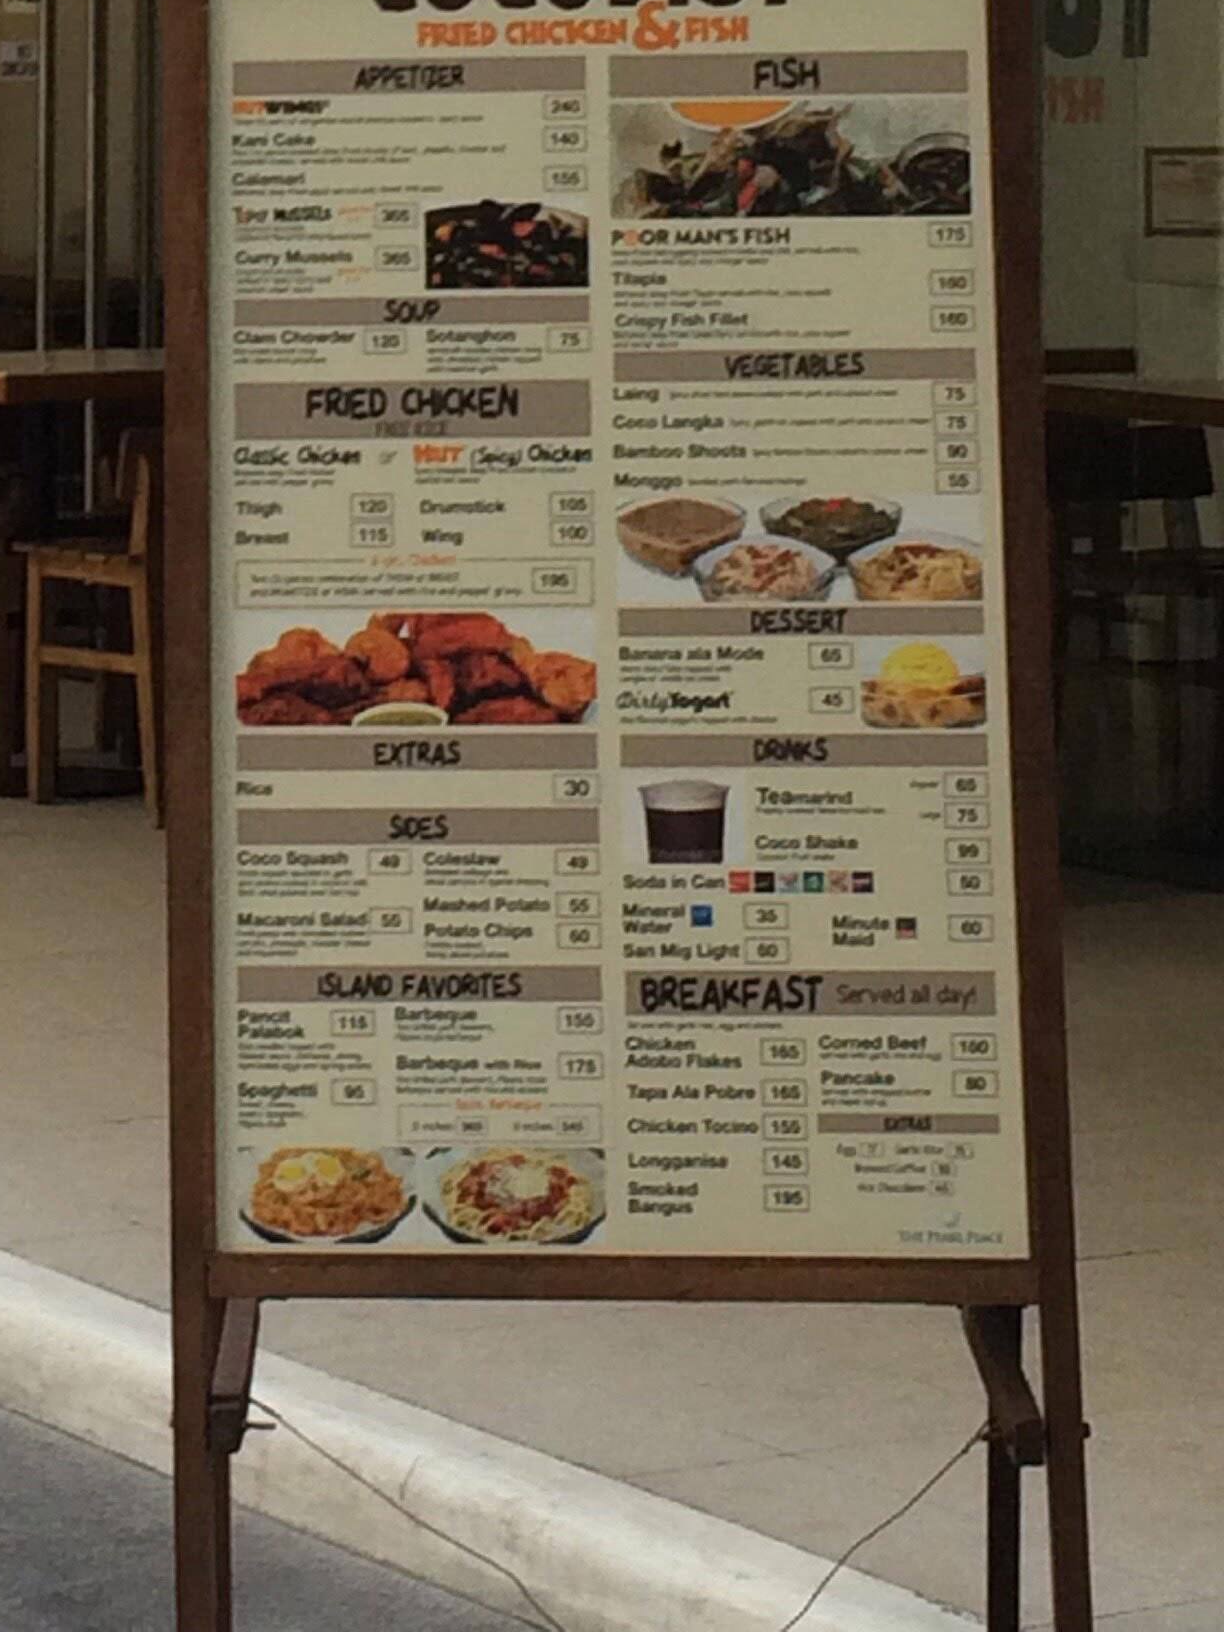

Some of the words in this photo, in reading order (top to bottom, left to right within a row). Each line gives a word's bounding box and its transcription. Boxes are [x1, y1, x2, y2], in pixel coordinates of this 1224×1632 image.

[417, 20, 496, 48] FRIED
[505, 19, 627, 46] CHICKEN
[633, 0, 681, 50] &
[685, 16, 749, 42] FISH
[754, 58, 820, 90] FISH
[551, 133, 579, 146] 140
[676, 228, 738, 244] MAN'S
[744, 227, 790, 244] FISH
[936, 228, 965, 242] 175
[235, 251, 279, 267] Curry
[285, 250, 352, 264] Mussels
[613, 273, 667, 287] Tilapia
[383, 300, 440, 323] SOUP
[615, 314, 667, 330] Crispy
[672, 313, 705, 326] Fish
[710, 313, 749, 326] Fillet
[233, 331, 274, 344] Clam
[280, 330, 355, 344] Chowder
[426, 329, 516, 345] Sotanghon
[560, 333, 580, 346] 75
[724, 352, 865, 379] VEGETABLES
[305, 388, 387, 419] FRIED
[401, 387, 518, 418] CHICKEN
[613, 388, 659, 402] Laing
[945, 388, 965, 401] 75
[613, 416, 658, 429] Coco
[662, 415, 724, 431] Langka
[947, 417, 967, 430] 75
[613, 445, 682, 459] Bamboo
[687, 444, 747, 458] Shoots
[614, 474, 682, 490] Monggo
[236, 502, 282, 518] Thigh
[420, 499, 506, 514] Drumstick
[236, 531, 288, 545] Breast
[359, 529, 387, 542] 115
[422, 530, 463, 546] Wing
[750, 609, 847, 634] DESSERT
[619, 647, 683, 661] Banana
[716, 646, 764, 660] Mode
[373, 741, 462, 767] EXTRAS
[753, 738, 828, 761] DRINKS
[236, 781, 273, 796] Rice
[564, 780, 590, 796] 30
[756, 787, 853, 806] Teamarind
[958, 809, 978, 823] 75
[388, 816, 449, 841] SIDES
[755, 835, 800, 850] Coco
[805, 835, 858, 849] Shake
[237, 850, 281, 866] Coco
[286, 850, 349, 867] Squash
[423, 851, 501, 866] Coleslaw
[622, 874, 667, 889] Soda
[671, 874, 687, 888] in
[691, 874, 726, 889] Can
[423, 898, 490, 913] Mashed
[495, 898, 550, 912] Potato
[622, 903, 685, 918] Mineral
[236, 913, 315, 927] Macaroni
[320, 912, 369, 927] Salad
[622, 920, 673, 934] Water
[832, 916, 890, 931] Minute
[424, 924, 479, 938] Potato
[484, 923, 533, 940] Chips
[832, 932, 875, 947] Maid
[623, 944, 657, 959] San
[660, 944, 692, 961] Mig
[696, 944, 740, 961] Light
[317, 974, 392, 998] ISLAND
[402, 972, 522, 998] FAVORITES
[639, 975, 824, 1013] BREAKFAST
[836, 984, 905, 1005] Served
[910, 983, 932, 1004] all
[395, 1007, 477, 1024] Barbeque
[237, 1024, 305, 1038] Palabok
[624, 1038, 696, 1052] Chicken
[818, 1035, 883, 1050] Corned
[887, 1035, 927, 1050] Beef
[396, 1055, 478, 1072] Barbeque
[625, 1054, 682, 1069] Adobo
[686, 1054, 742, 1068] Flakes
[821, 1072, 894, 1085] Pancake
[237, 1083, 318, 1100] Spaghetti
[627, 1086, 668, 1101] Tapa
[671, 1085, 700, 1100] Ala
[704, 1085, 756, 1100] Pobre
[627, 1119, 697, 1134] Chicken
[702, 1119, 759, 1134] Tocino
[627, 1155, 727, 1170] Longganisa
[627, 1183, 698, 1197] Smoked
[627, 1199, 694, 1216] Bangus
